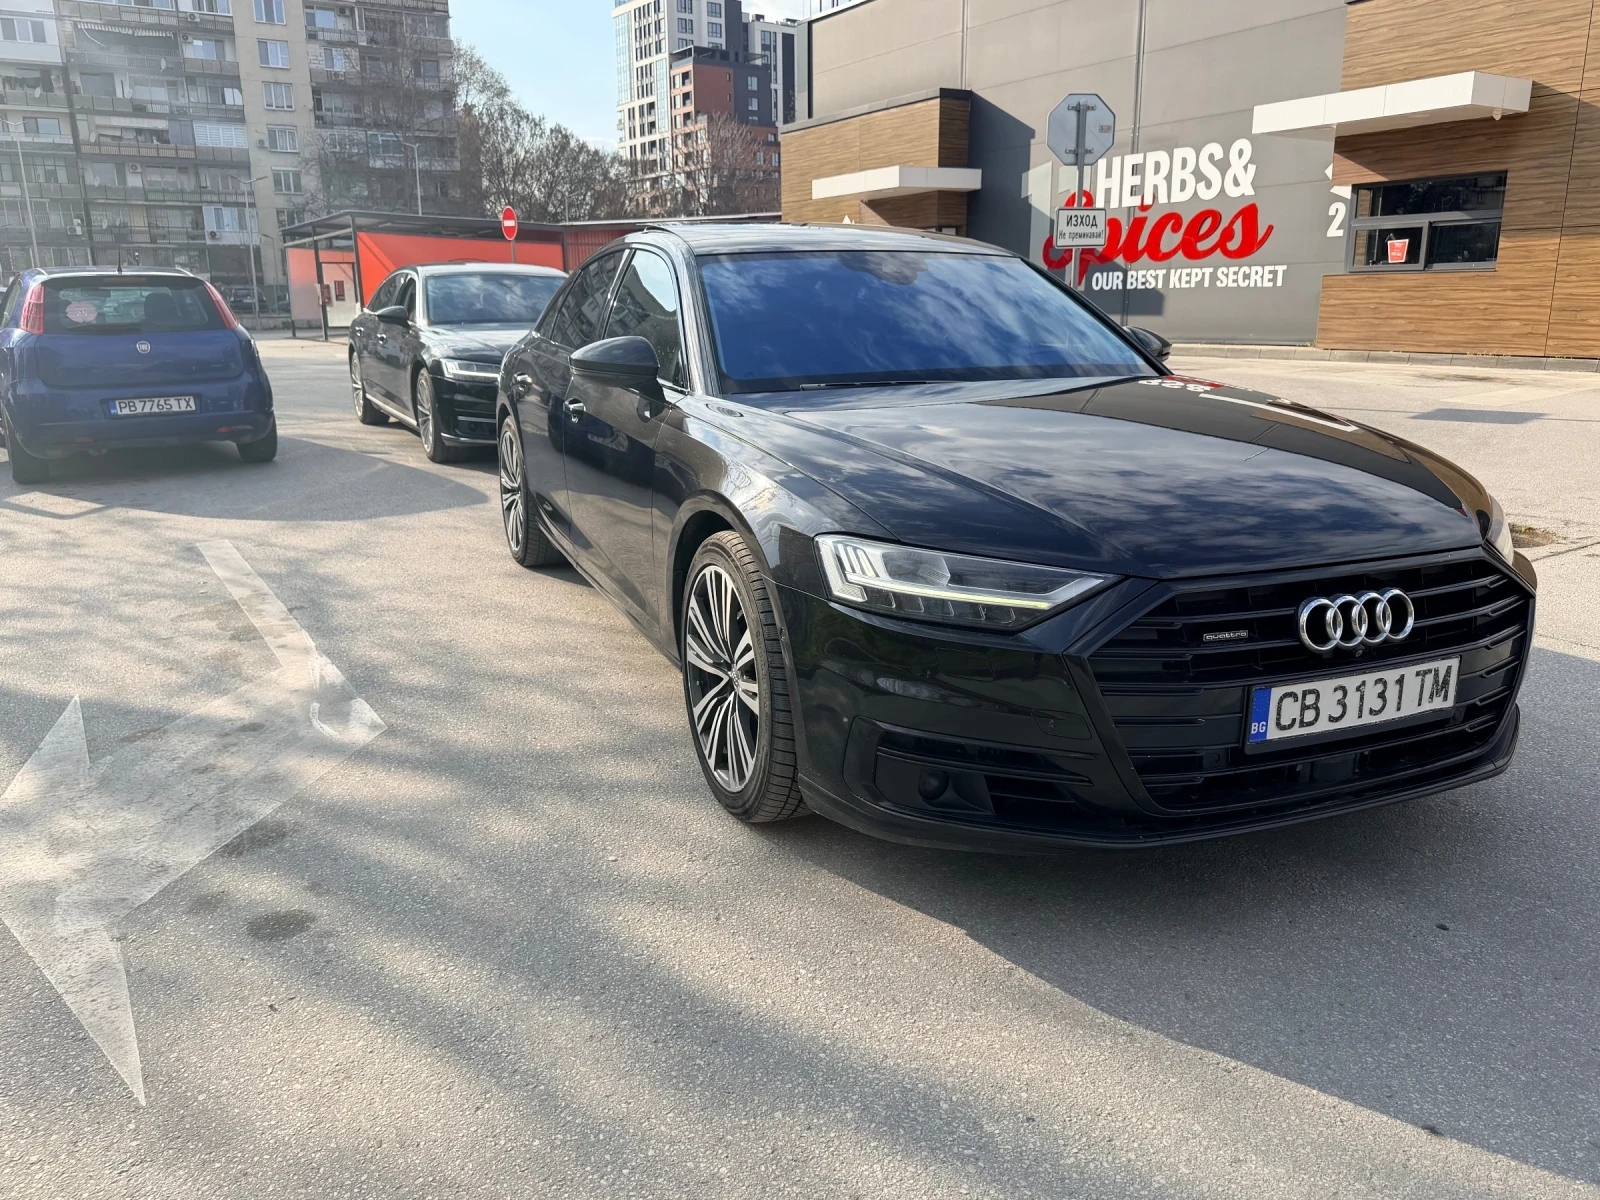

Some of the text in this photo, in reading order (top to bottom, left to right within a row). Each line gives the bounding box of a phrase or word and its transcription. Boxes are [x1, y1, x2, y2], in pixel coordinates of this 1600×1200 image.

[1066, 214, 1098, 228] ИЗХОД
[1326, 201, 1346, 238] 2
[1059, 230, 1104, 241] Не преминавай!
[1092, 265, 1287, 291] OUR BEST KEPT SECRET
[118, 400, 137, 413] PB
[138, 398, 173, 412] 7765
[174, 397, 193, 410] TX
[1205, 631, 1247, 641] quattro
[1275, 664, 1453, 731] CB 3131 TM
[1251, 721, 1266, 735] BG
